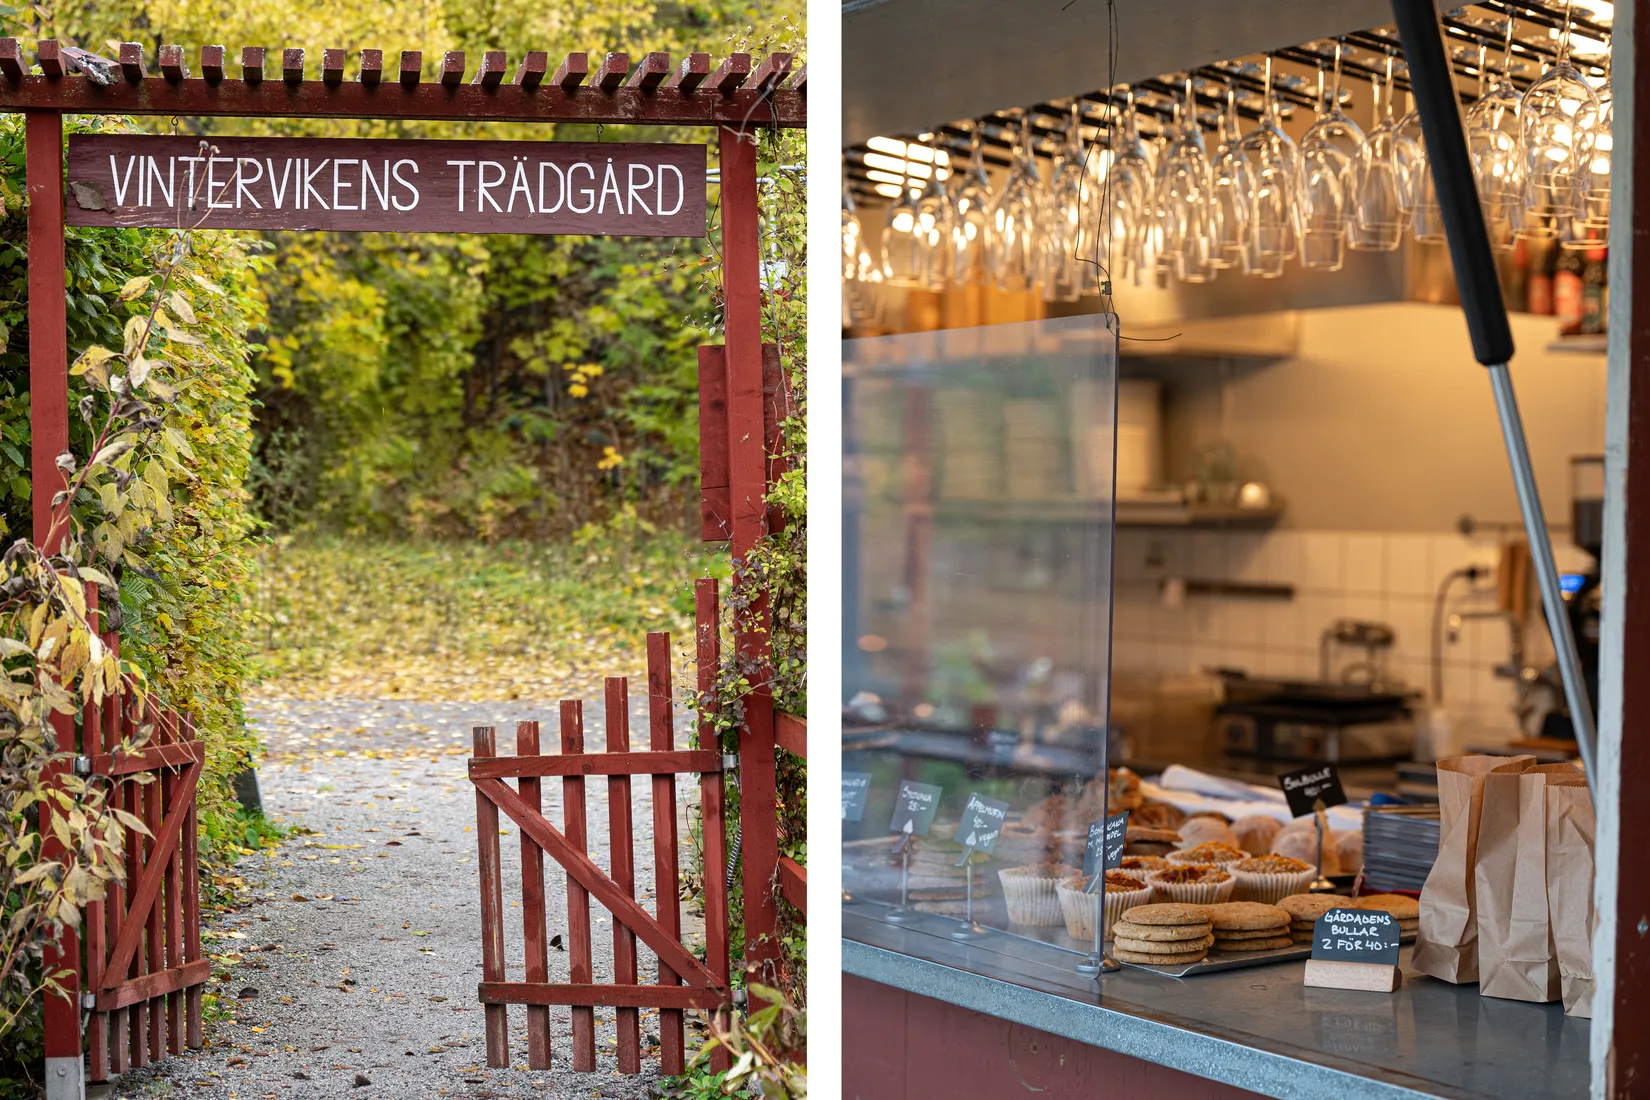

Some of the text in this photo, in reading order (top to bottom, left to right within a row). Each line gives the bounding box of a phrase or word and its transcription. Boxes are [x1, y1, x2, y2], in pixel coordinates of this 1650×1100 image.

[109, 154, 685, 217] VINTERVIKENS TRÄDGÅRD
[1324, 909, 1391, 925] GÅRDAGENS
[1331, 924, 1379, 937] BULLAR
[1322, 938, 1332, 950] 2
[1337, 937, 1363, 951] FÖR
